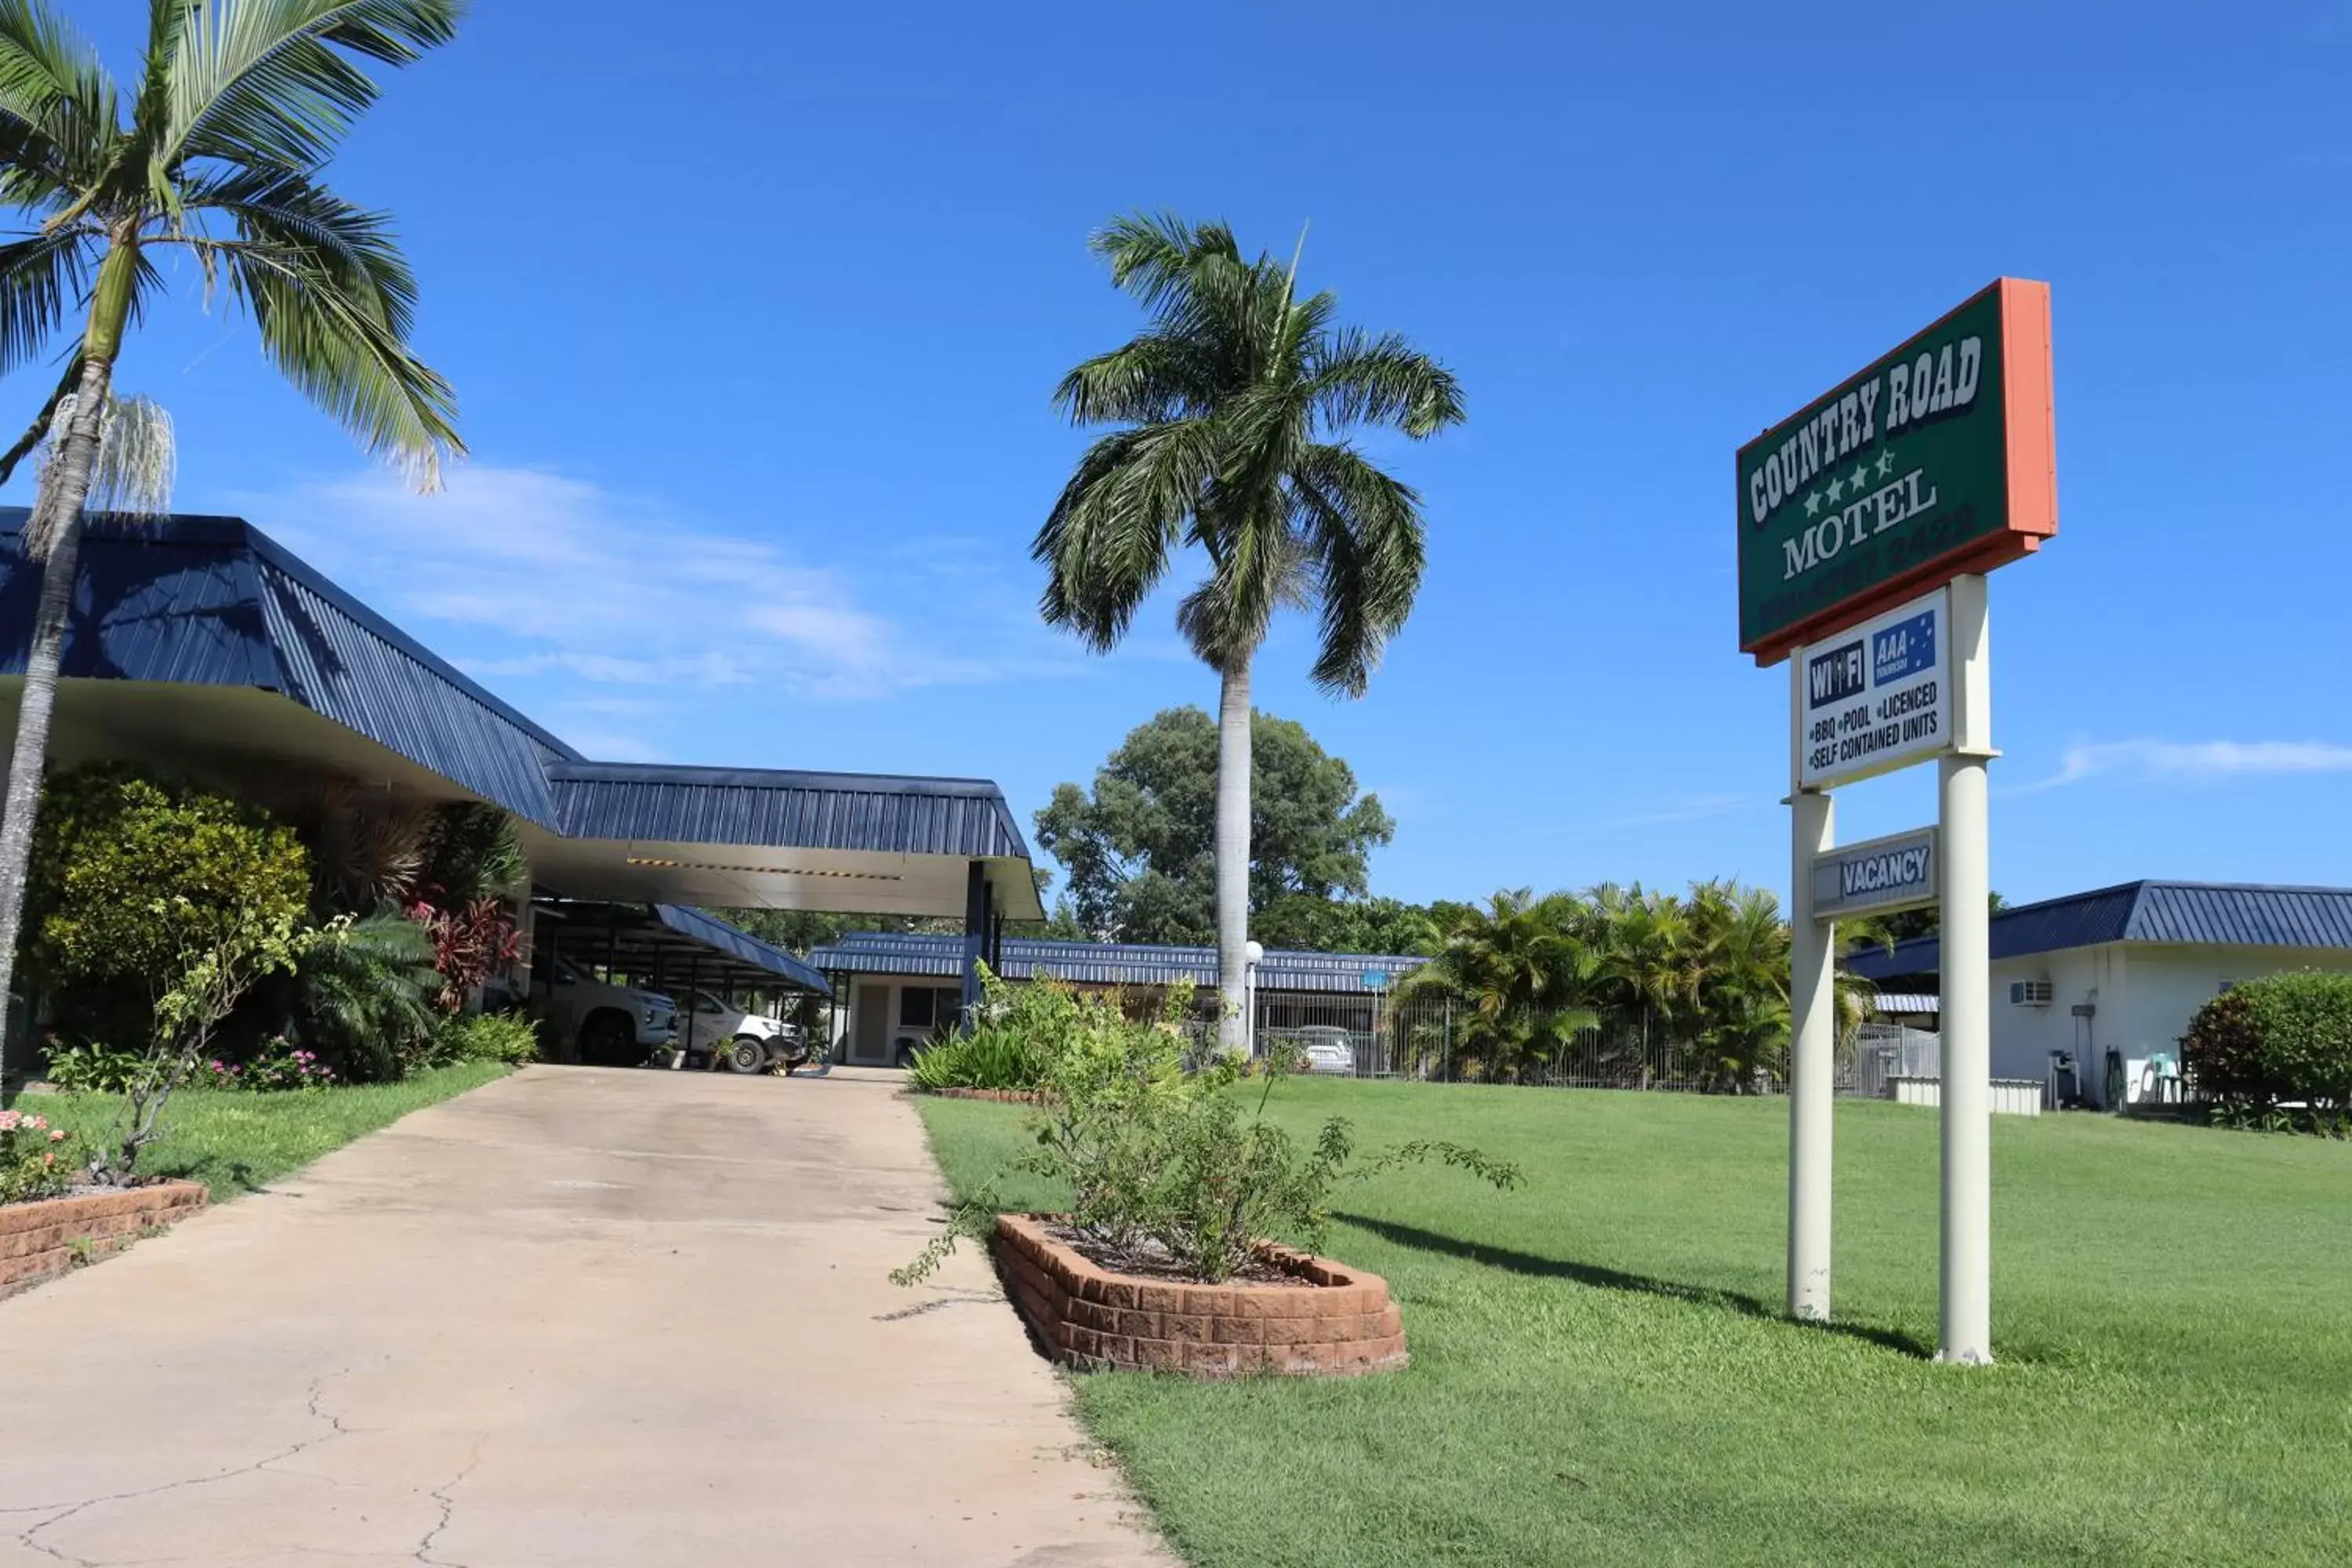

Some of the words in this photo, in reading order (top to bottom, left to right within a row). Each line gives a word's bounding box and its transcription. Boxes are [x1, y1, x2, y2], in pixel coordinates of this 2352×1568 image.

[1750, 376, 1880, 524] COUNTRY
[1886, 336, 1982, 430] ROAD
[1782, 468, 1937, 581] MOTEL
[1876, 630, 1907, 665] AAA
[1813, 743, 1838, 771] SELF
[1840, 723, 1900, 762] CONTAINED
[1903, 710, 1937, 742] UNITS
[1814, 717, 1835, 743] BBQ
[1843, 706, 1871, 734] POOL
[1882, 681, 1937, 720] LICENCED
[1843, 846, 1929, 895] VACANCY
